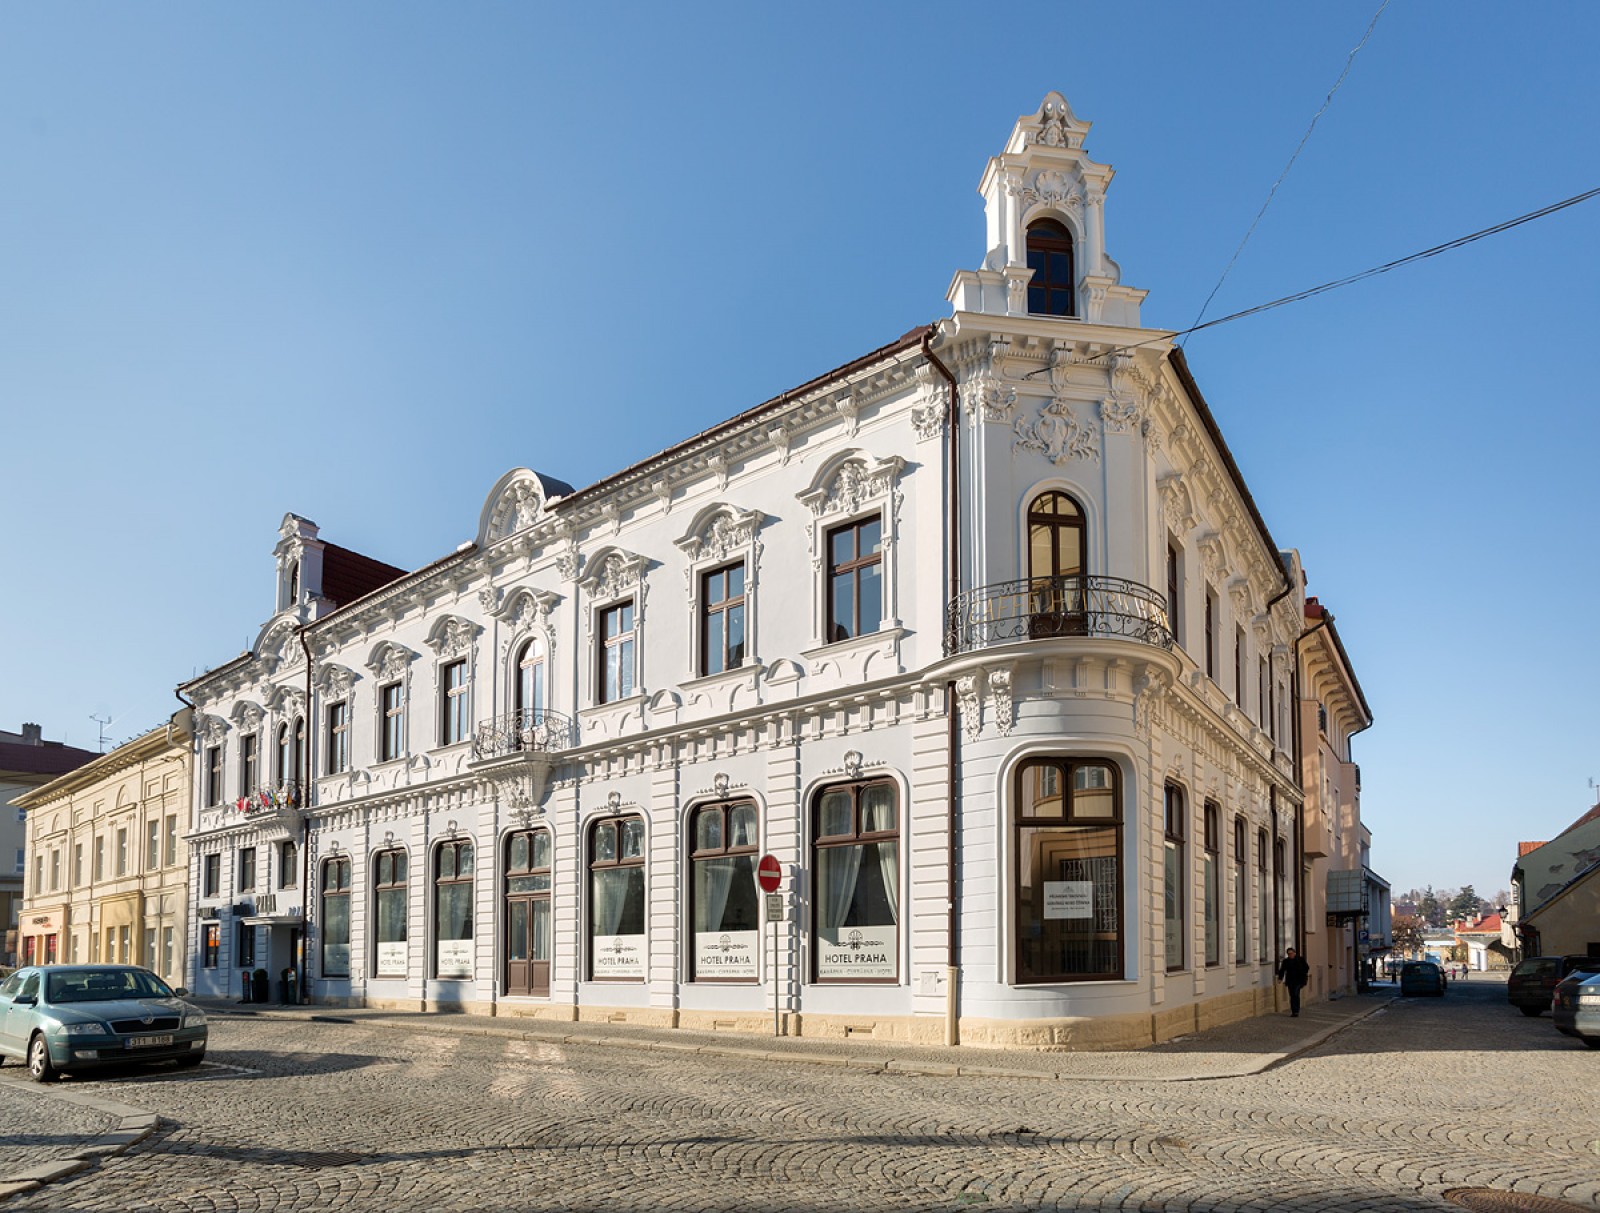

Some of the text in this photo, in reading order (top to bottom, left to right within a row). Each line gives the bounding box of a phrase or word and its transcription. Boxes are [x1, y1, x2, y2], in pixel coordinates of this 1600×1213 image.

[598, 956, 640, 966] HOTEL PRAHA
[700, 955, 752, 965] HOTEL PRAHA
[824, 953, 888, 963] HOTEL PRAHA
